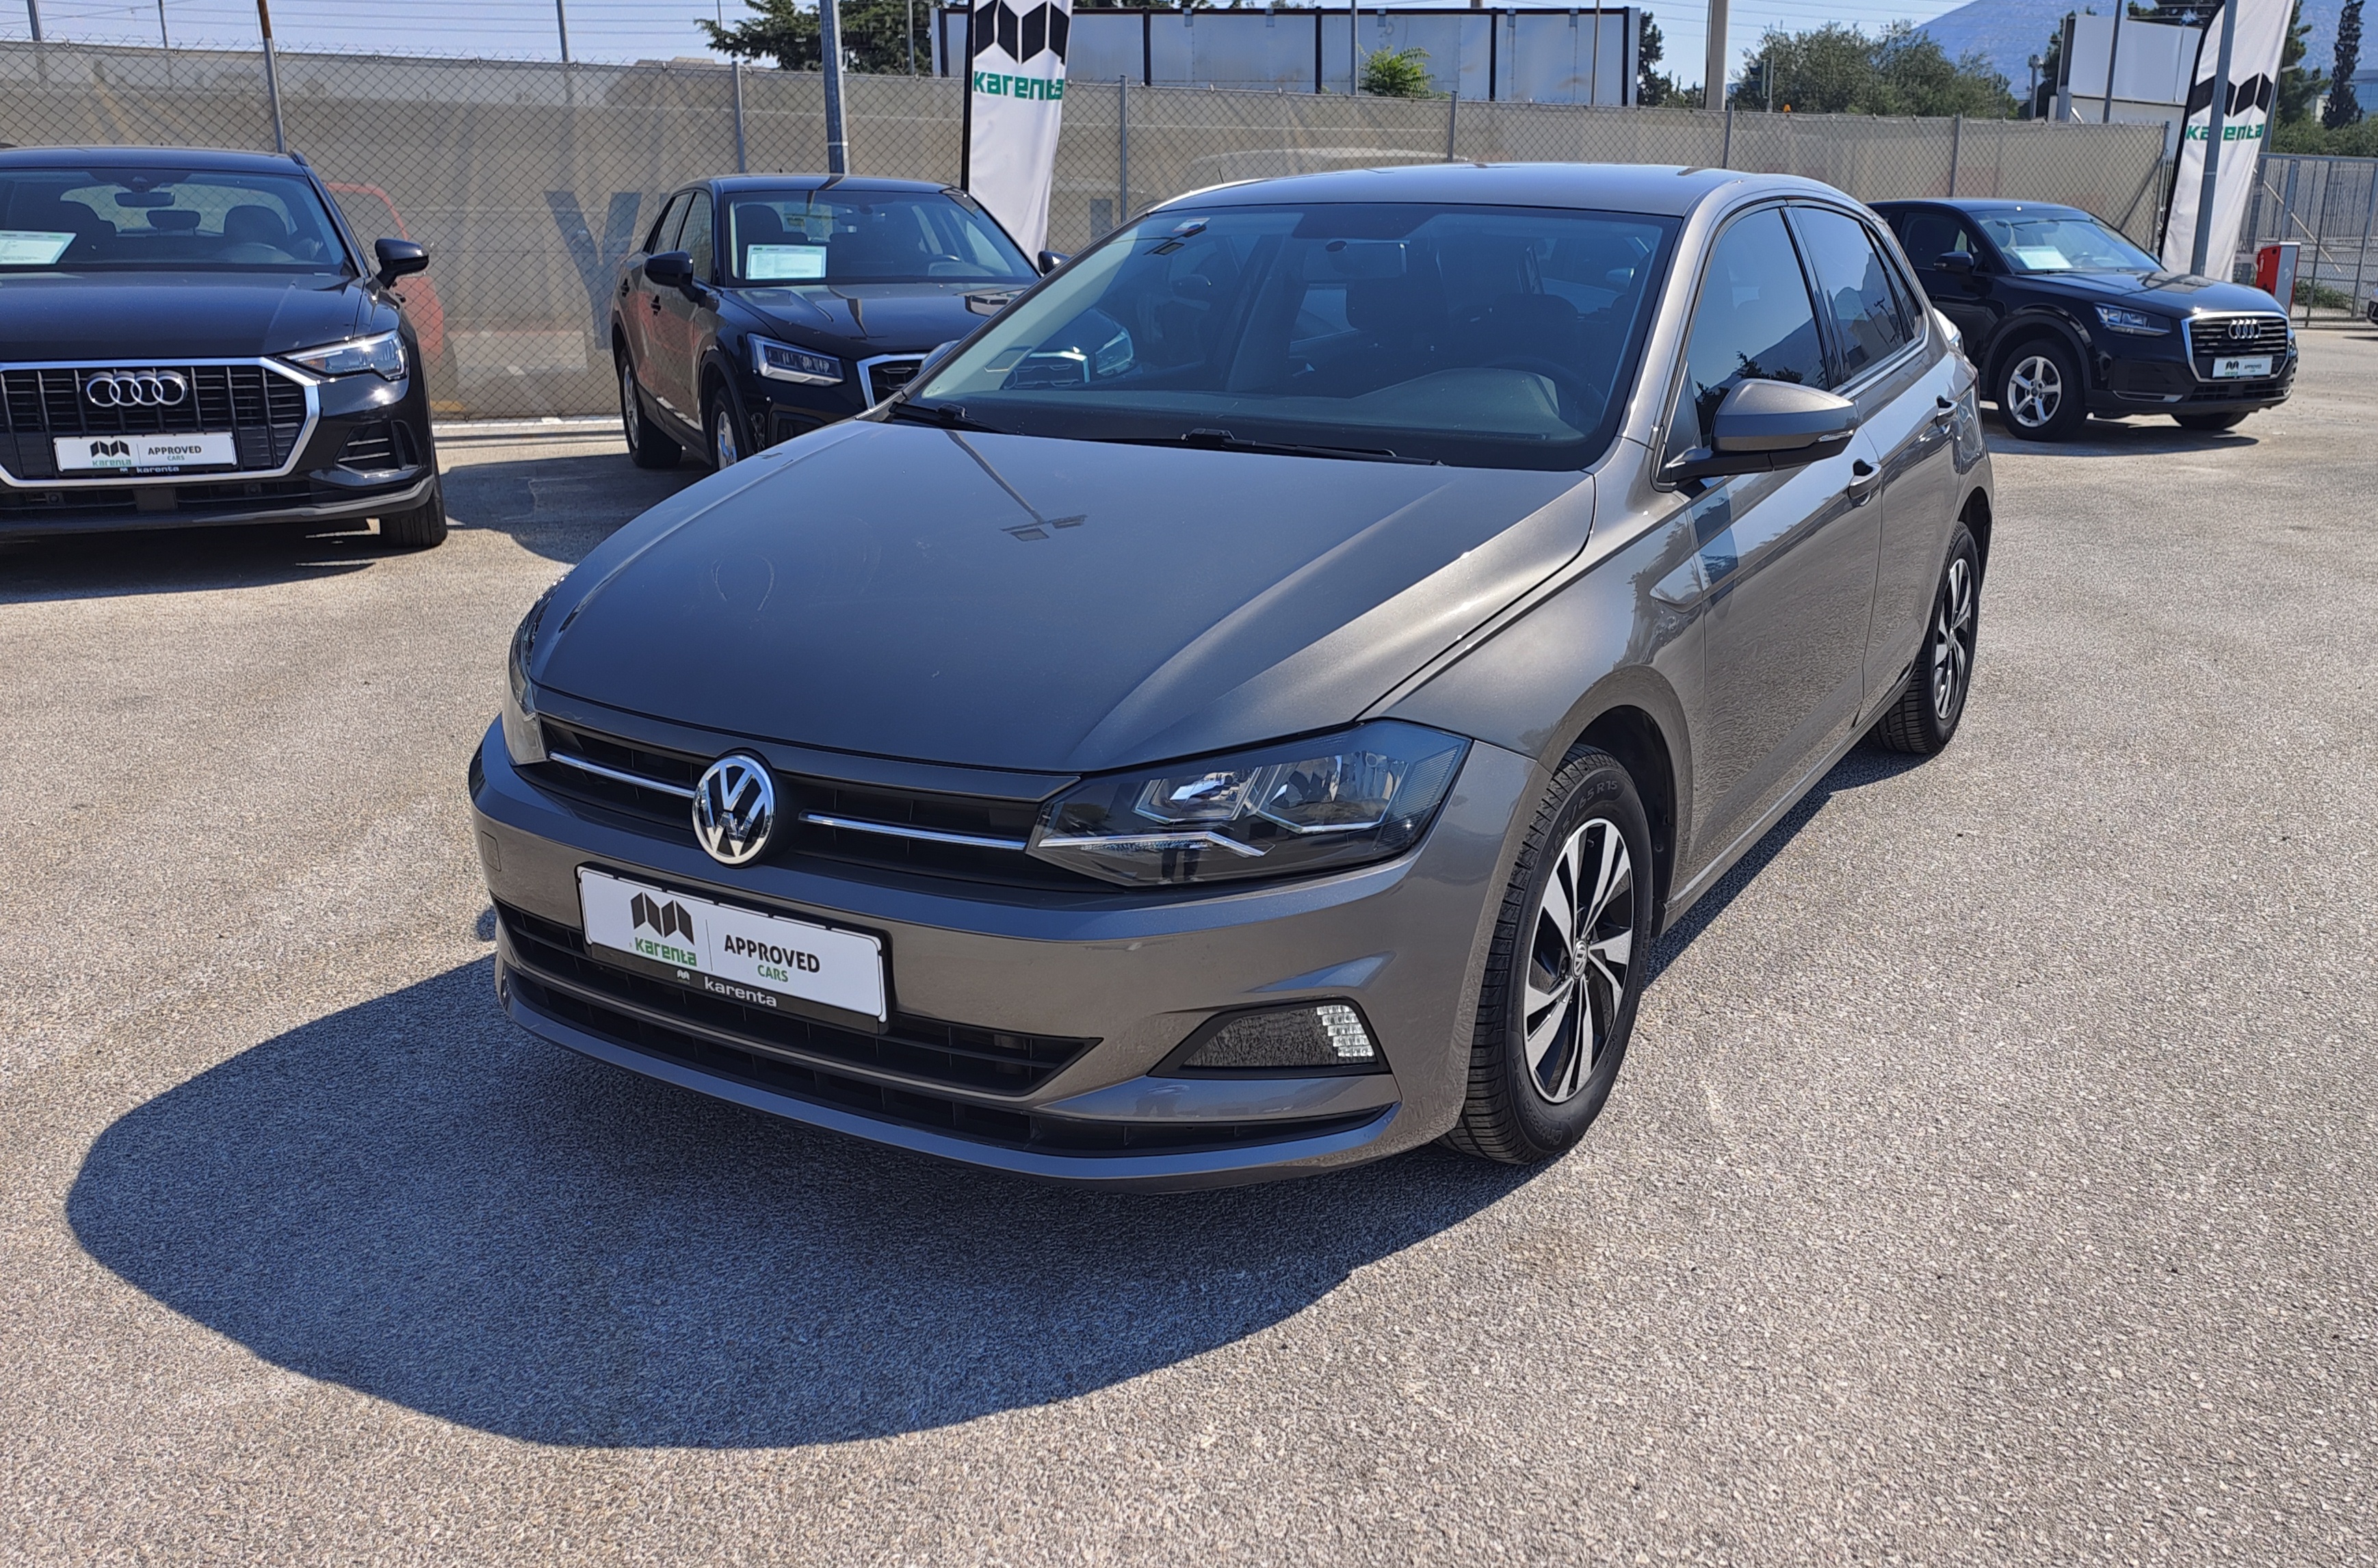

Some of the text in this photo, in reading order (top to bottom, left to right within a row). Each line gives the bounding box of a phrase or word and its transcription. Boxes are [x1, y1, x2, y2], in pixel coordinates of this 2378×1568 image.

[974, 71, 1064, 101] karenta
[2186, 124, 2264, 141] kaenta
[148, 445, 202, 456] APPROVED
[92, 458, 132, 467] karenta
[1596, 780, 1619, 795] R15
[634, 937, 698, 967] karenta
[724, 934, 820, 974] APPROVED
[757, 965, 789, 983] CARS
[704, 976, 778, 1008] karenta
